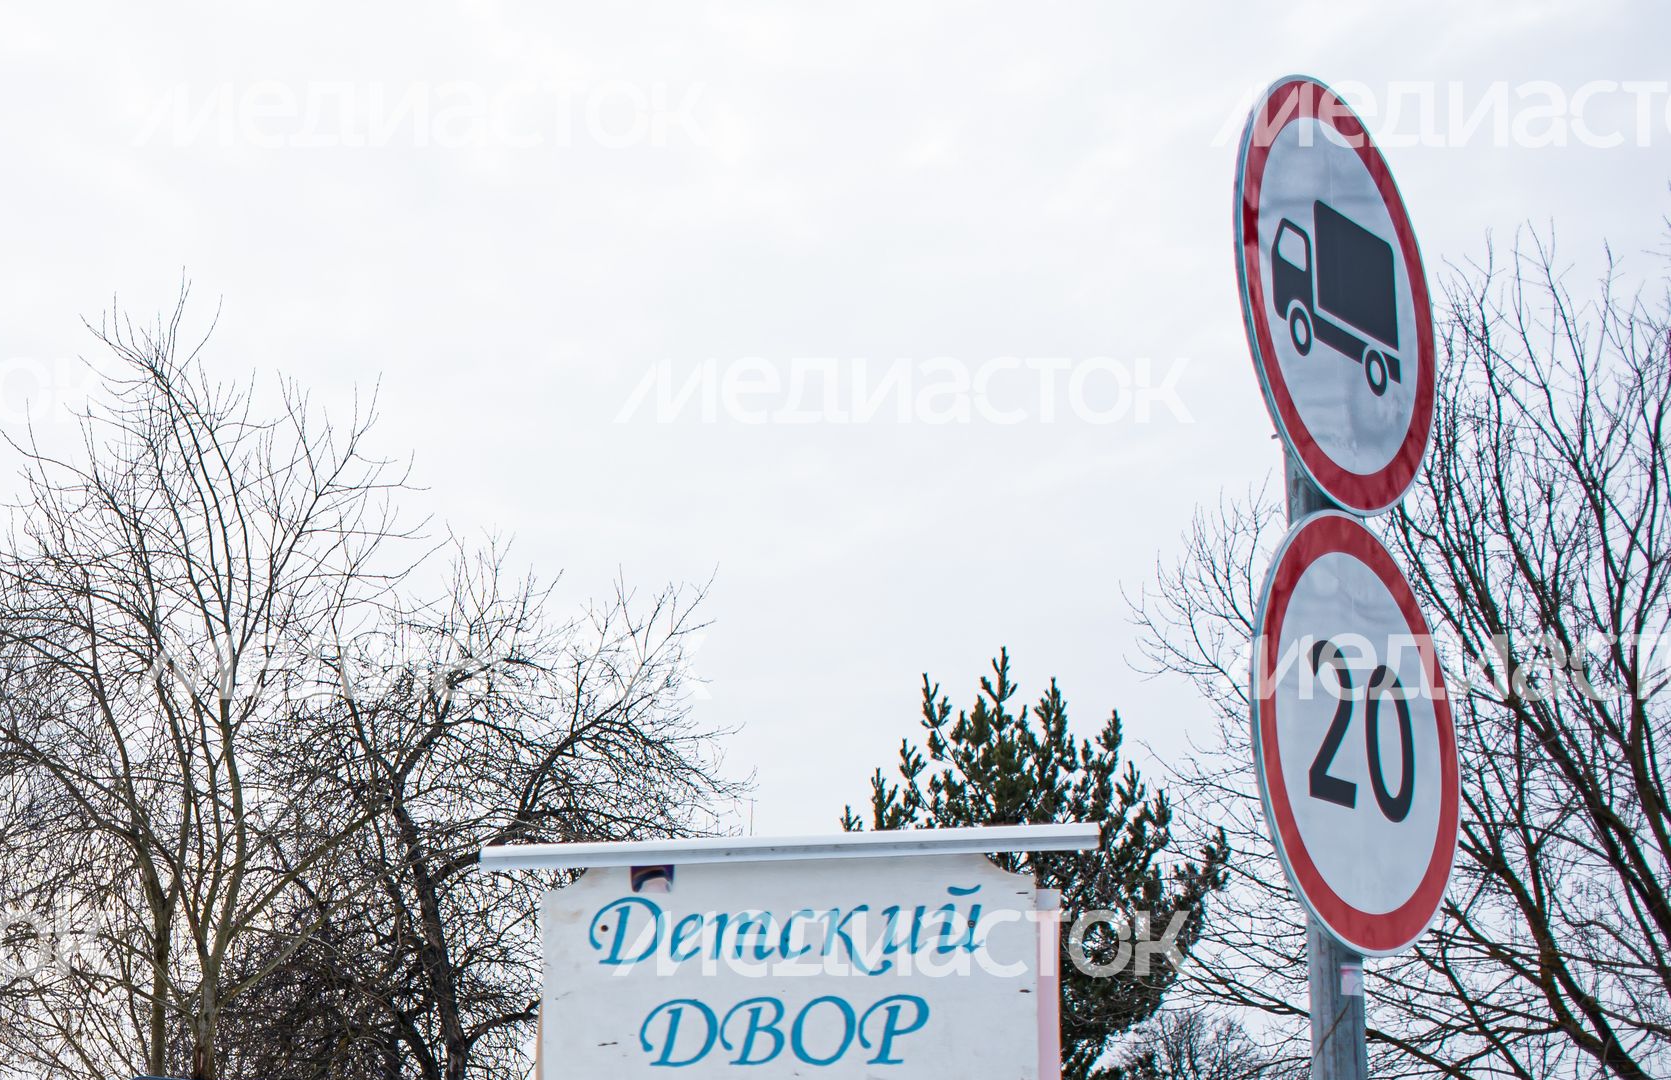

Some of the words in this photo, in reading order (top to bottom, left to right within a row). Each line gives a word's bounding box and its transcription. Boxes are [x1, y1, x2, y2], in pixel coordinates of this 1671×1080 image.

[1306, 638, 1415, 824] 20
[588, 883, 985, 977] Детский
[639, 993, 930, 1068] ДВОР
